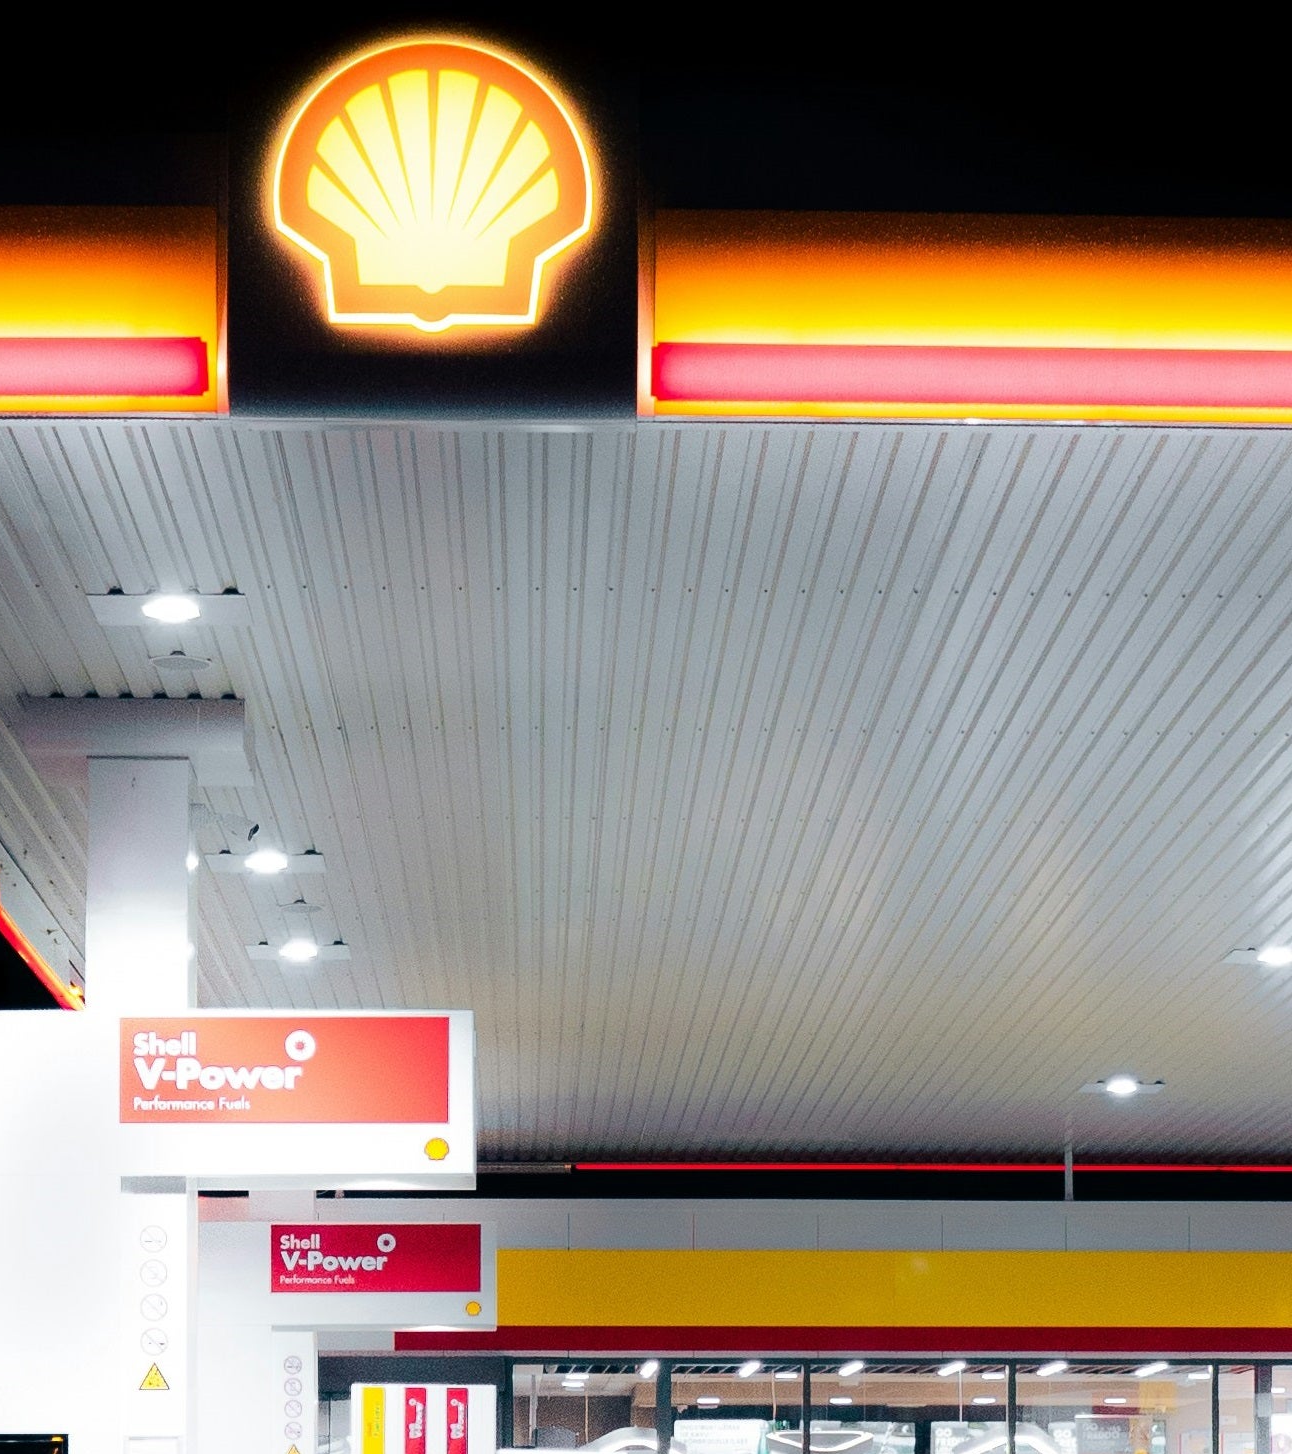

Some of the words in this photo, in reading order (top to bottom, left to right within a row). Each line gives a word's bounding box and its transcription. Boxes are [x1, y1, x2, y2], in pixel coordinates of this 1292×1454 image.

[133, 1031, 197, 1056] Shell
[133, 1057, 303, 1091] V-Power
[133, 1095, 215, 1111] Performance
[219, 1095, 251, 1111] Fuels
[279, 1233, 320, 1250] Shell
[280, 1250, 388, 1271] V-Power
[279, 1274, 332, 1285] Performance
[334, 1274, 356, 1285] Fuels
